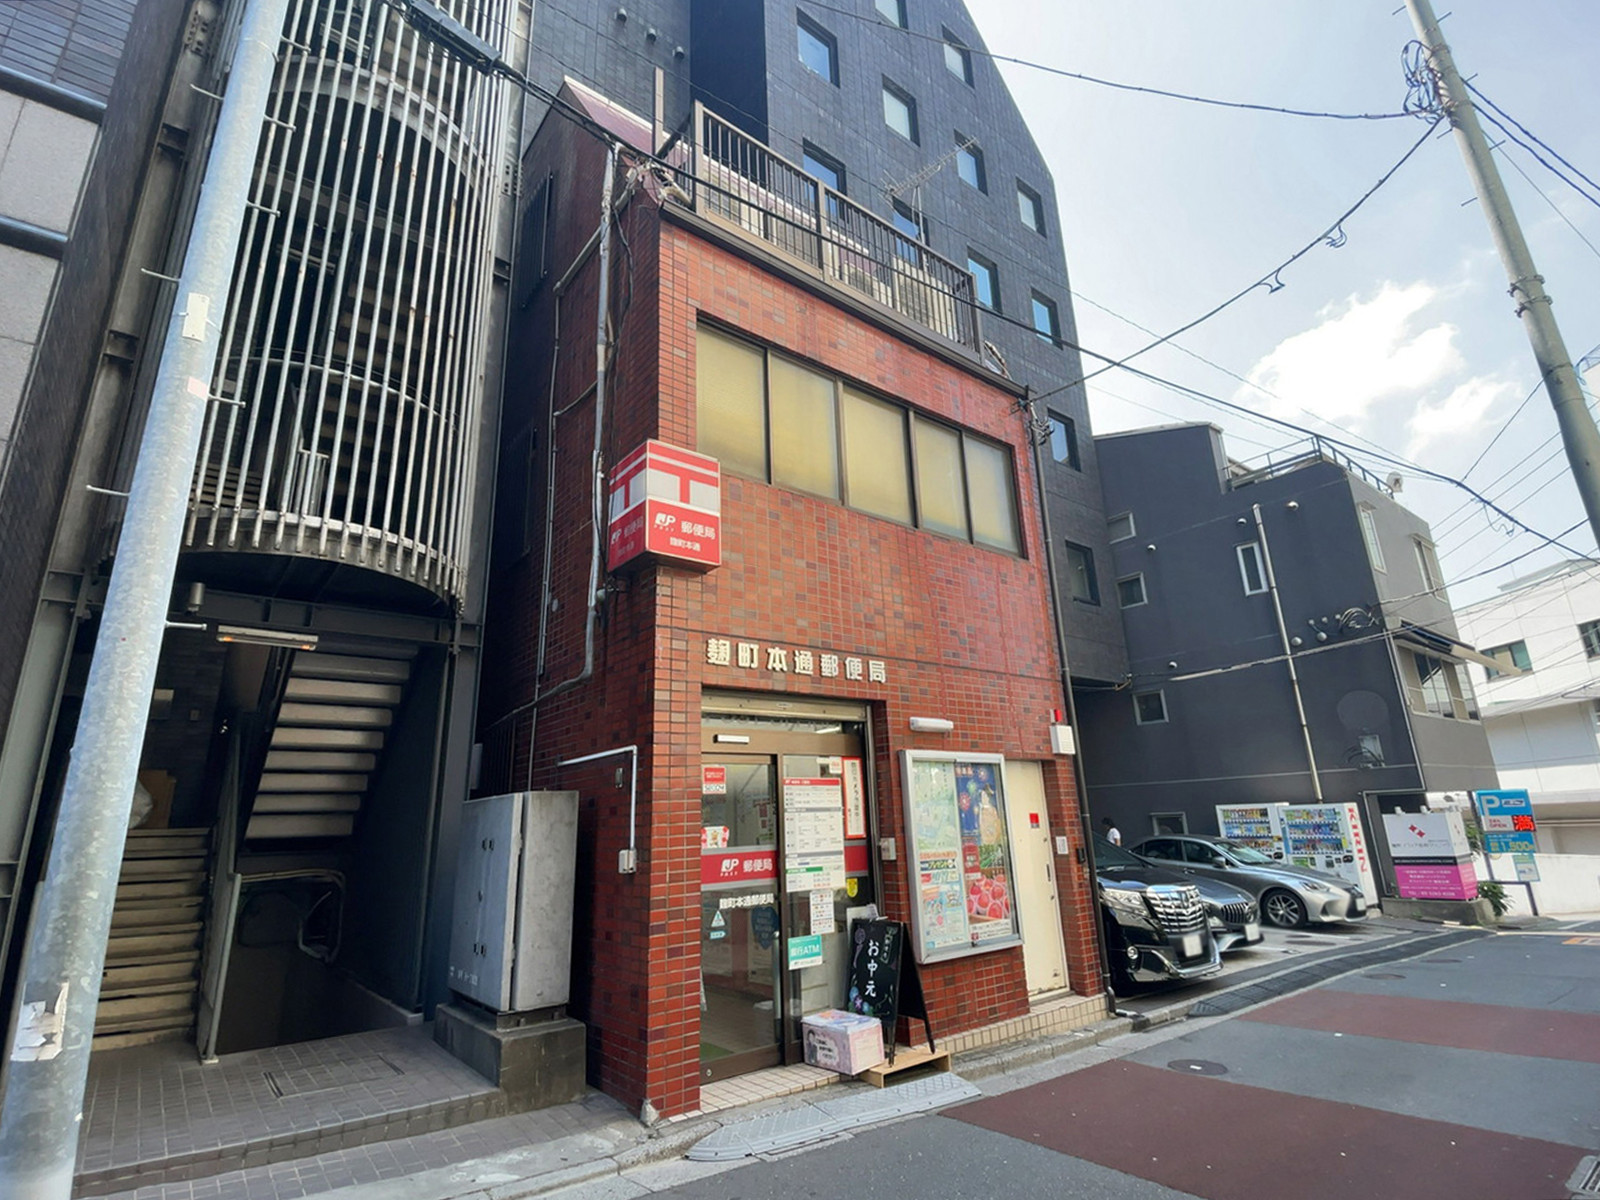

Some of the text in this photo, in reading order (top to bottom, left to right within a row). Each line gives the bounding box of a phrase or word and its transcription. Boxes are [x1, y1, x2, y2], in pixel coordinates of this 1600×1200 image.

[681, 520, 716, 540] 郵便局
[707, 638, 887, 683] 麹町本通郵便局
[1480, 795, 1500, 818] P
[1513, 815, 1534, 831] 満
[743, 858, 773, 873] 郵便局
[864, 939, 879, 997] お中元
